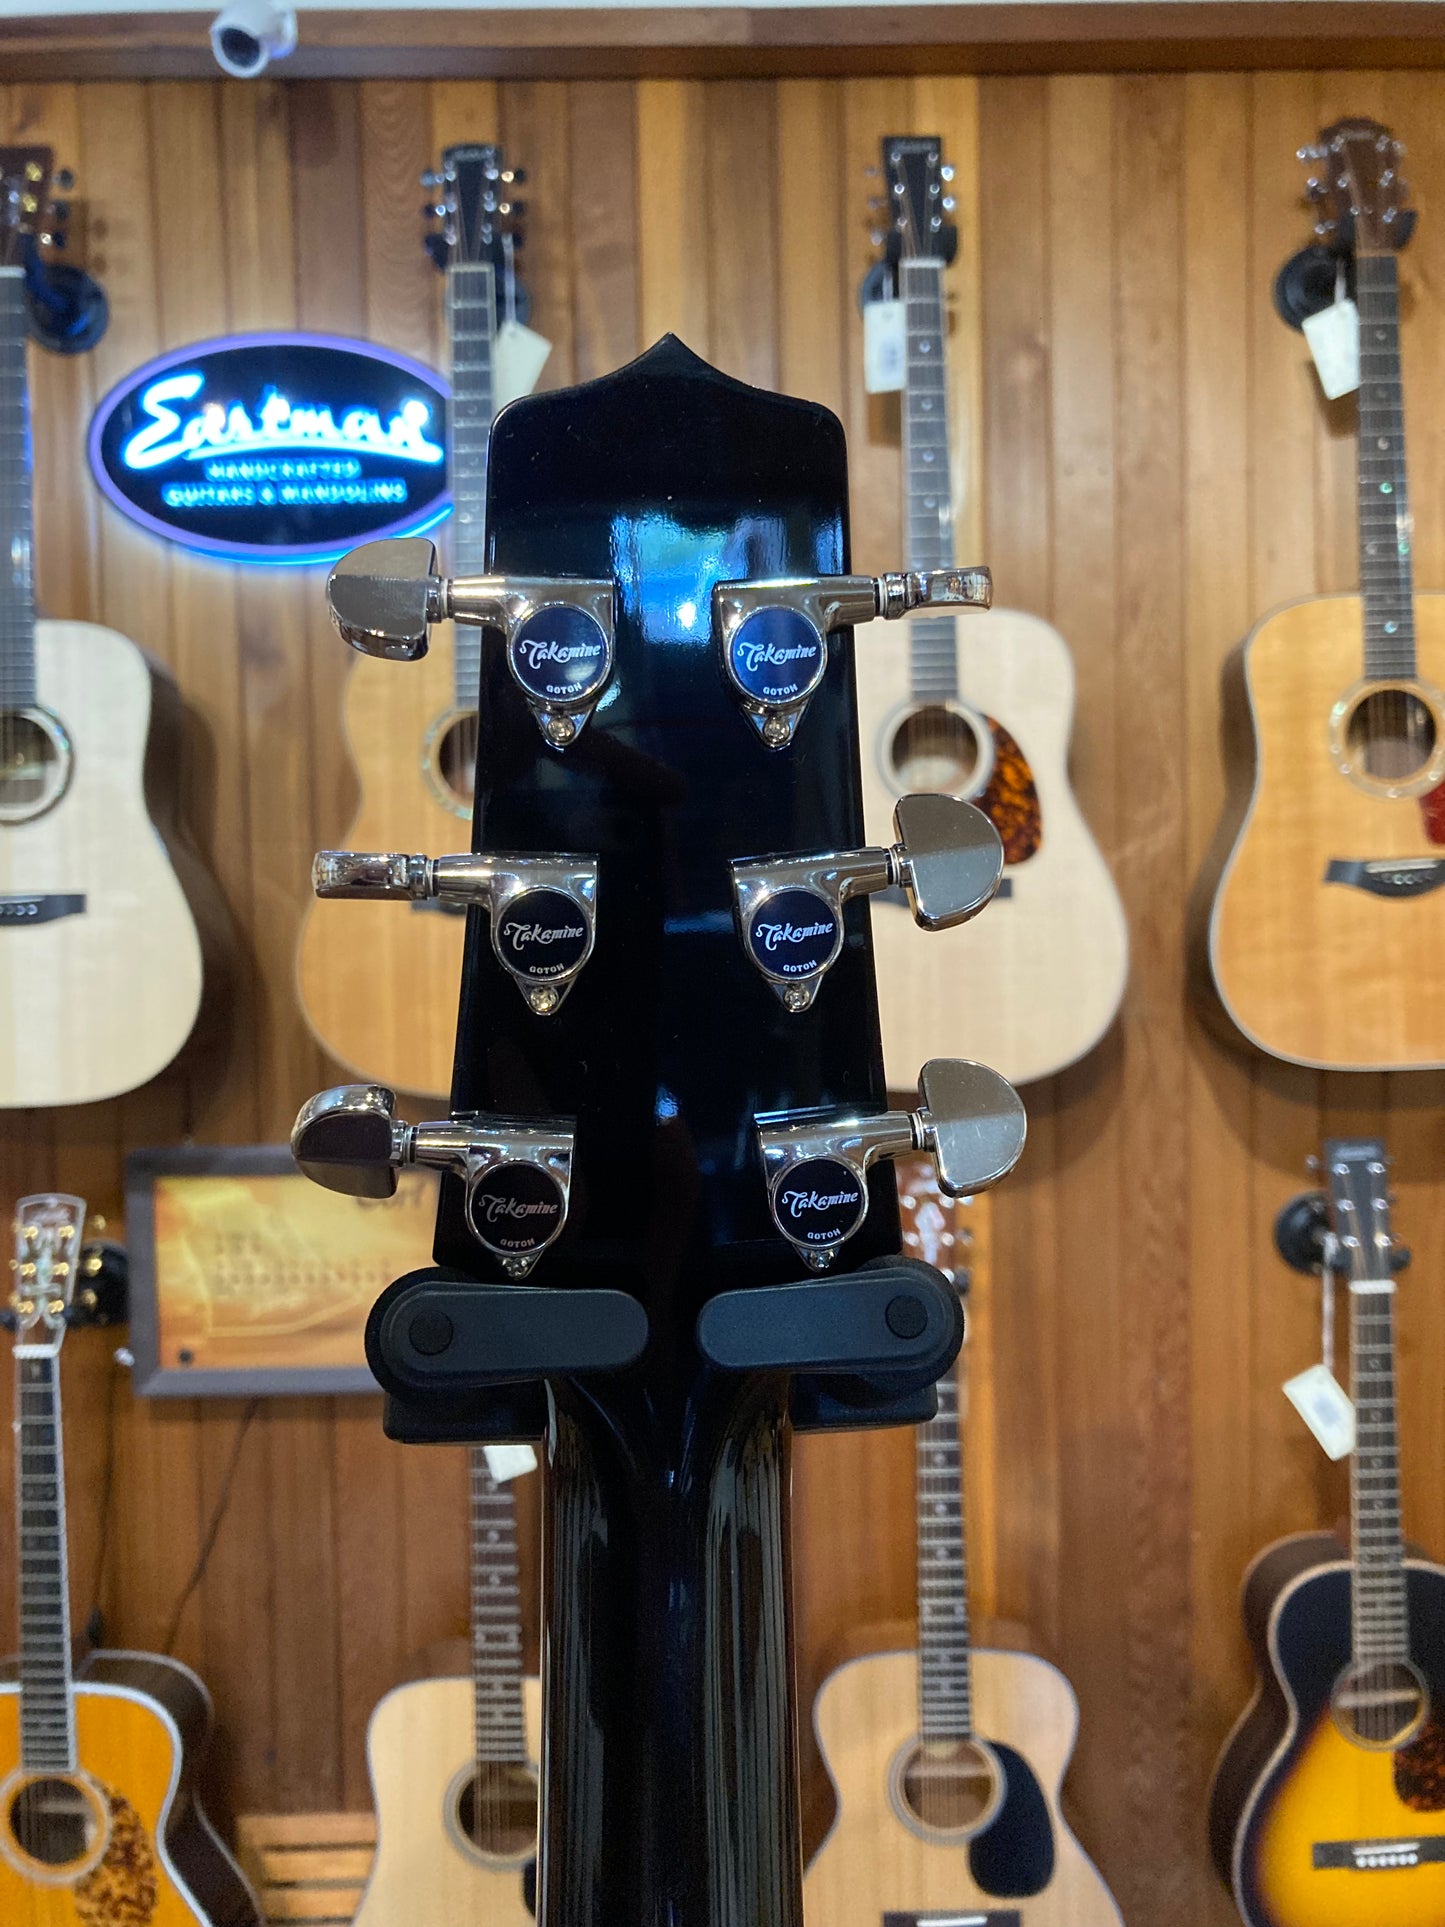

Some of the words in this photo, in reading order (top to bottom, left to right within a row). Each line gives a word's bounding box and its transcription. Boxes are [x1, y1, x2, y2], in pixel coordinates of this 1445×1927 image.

[125, 370, 443, 468] Eastman
[519, 640, 601, 669] Takamine
[737, 642, 817, 672] Takamine
[546, 682, 582, 695] GOTOH
[763, 684, 798, 696] GOTOH
[503, 922, 584, 951] Takamine
[756, 922, 834, 951] Takamine
[529, 963, 565, 975] GOTOH
[783, 960, 817, 973] GOTOH
[478, 1194, 558, 1222] Takamine
[782, 1190, 859, 1218] Takamine
[500, 1238, 535, 1248] GOTOH
[807, 1228, 841, 1240] GOTOH
